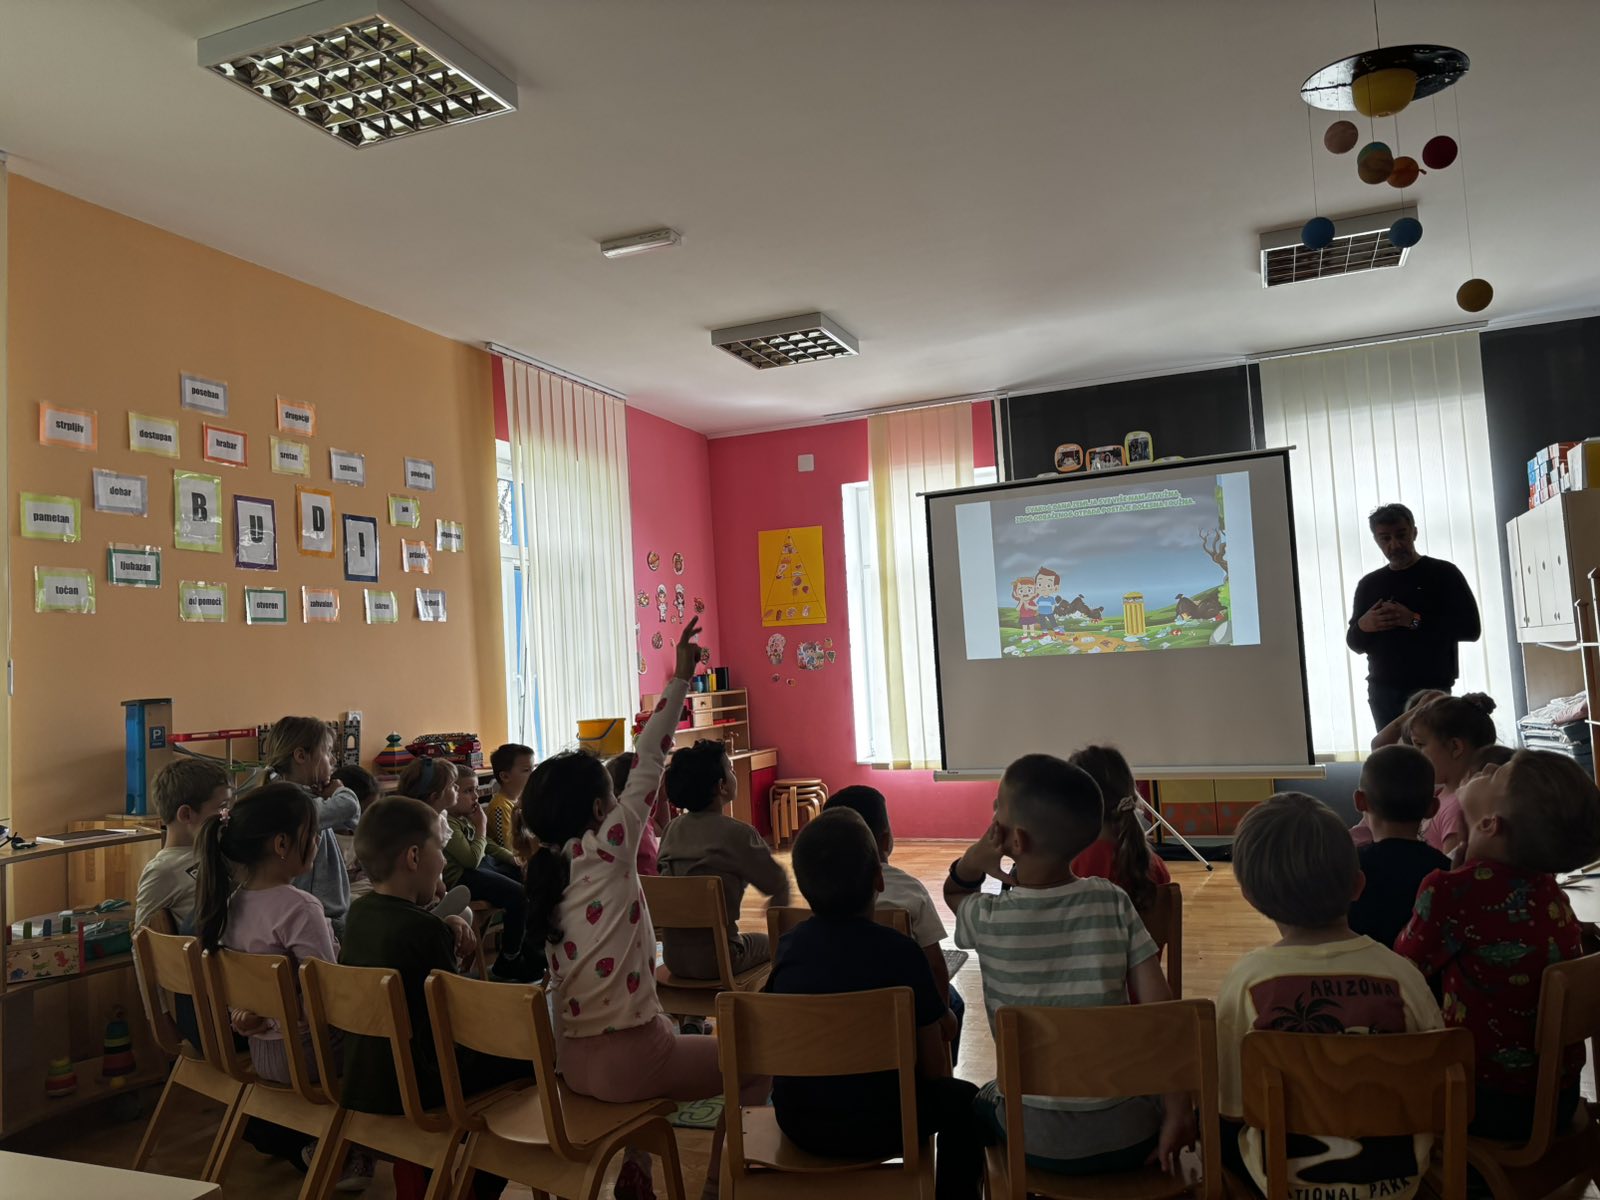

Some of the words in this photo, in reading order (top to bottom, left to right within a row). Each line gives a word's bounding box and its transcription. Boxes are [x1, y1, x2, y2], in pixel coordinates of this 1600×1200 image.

[191, 386, 219, 400] poseban
[55, 420, 84, 433] strpljiv
[139, 429, 172, 443] dostupan
[215, 438, 237, 450] hrabar
[279, 451, 299, 461] sretan
[109, 486, 132, 497] dobar
[32, 512, 70, 524] pametan
[191, 491, 207, 522] B
[249, 515, 263, 543] U
[312, 505, 325, 532] D
[358, 532, 365, 557] I
[120, 560, 151, 572] ljubazan
[55, 584, 79, 596] točan
[256, 601, 279, 610] otvoren
[153, 729, 161, 740] P
[1310, 978, 1395, 998] ARIZONA
[1287, 1186, 1360, 1200] TIONAL
[1369, 1175, 1411, 1199] PARK
